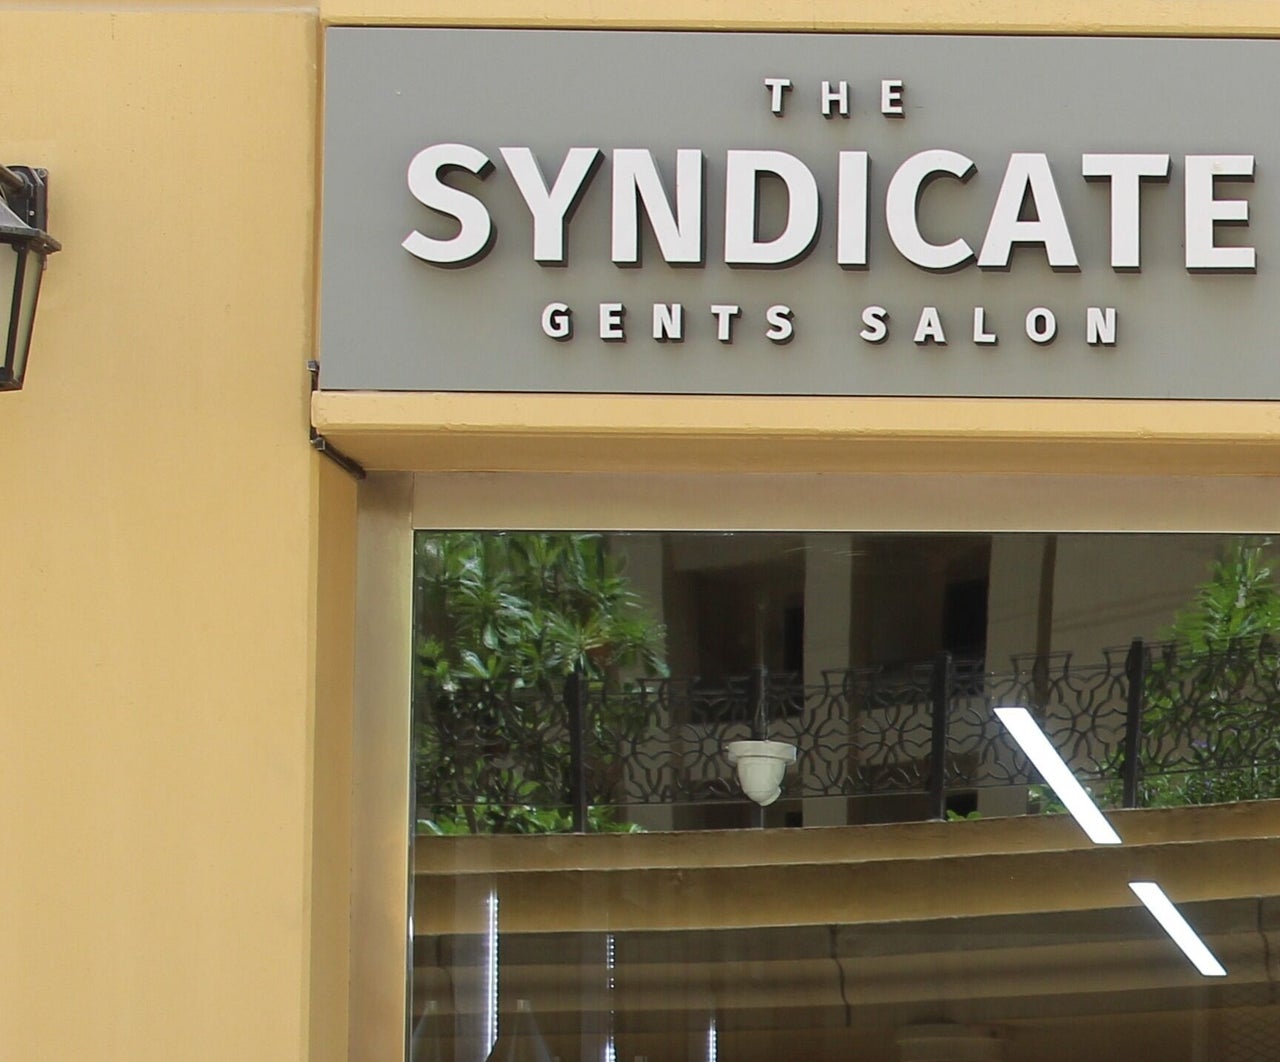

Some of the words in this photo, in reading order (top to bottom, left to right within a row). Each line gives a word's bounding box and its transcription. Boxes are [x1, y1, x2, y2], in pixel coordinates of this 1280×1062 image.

[763, 77, 904, 115] THE
[400, 141, 1257, 270] SYNDICATE
[540, 301, 793, 341] GENTS
[859, 305, 1116, 344] SALON
